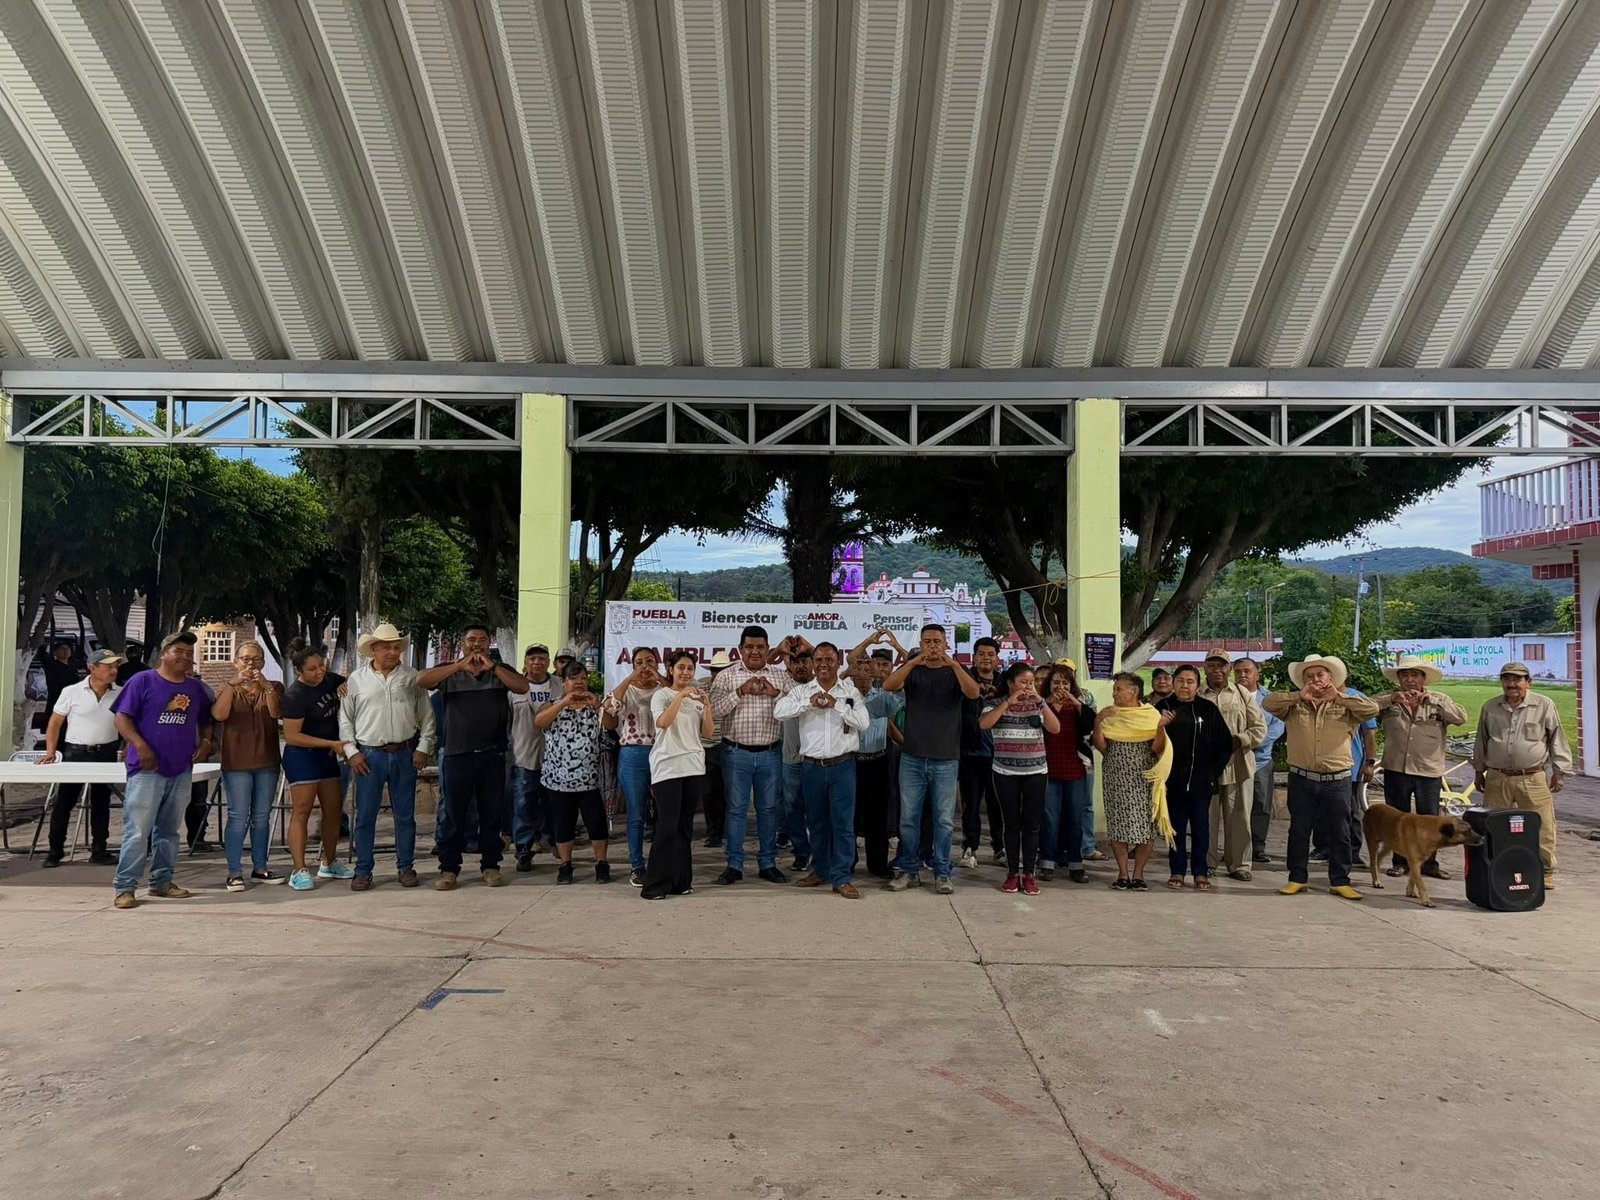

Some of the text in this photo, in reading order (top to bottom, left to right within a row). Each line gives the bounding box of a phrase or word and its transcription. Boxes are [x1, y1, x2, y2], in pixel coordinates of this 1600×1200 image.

[632, 609, 686, 619] PUEBLA
[702, 610, 778, 624] Bienestar
[807, 612, 839, 620] AMOR
[873, 613, 914, 623] Pensar
[794, 620, 848, 630] PUEBLA
[1451, 643, 1504, 654] JAIME LOYOLA
